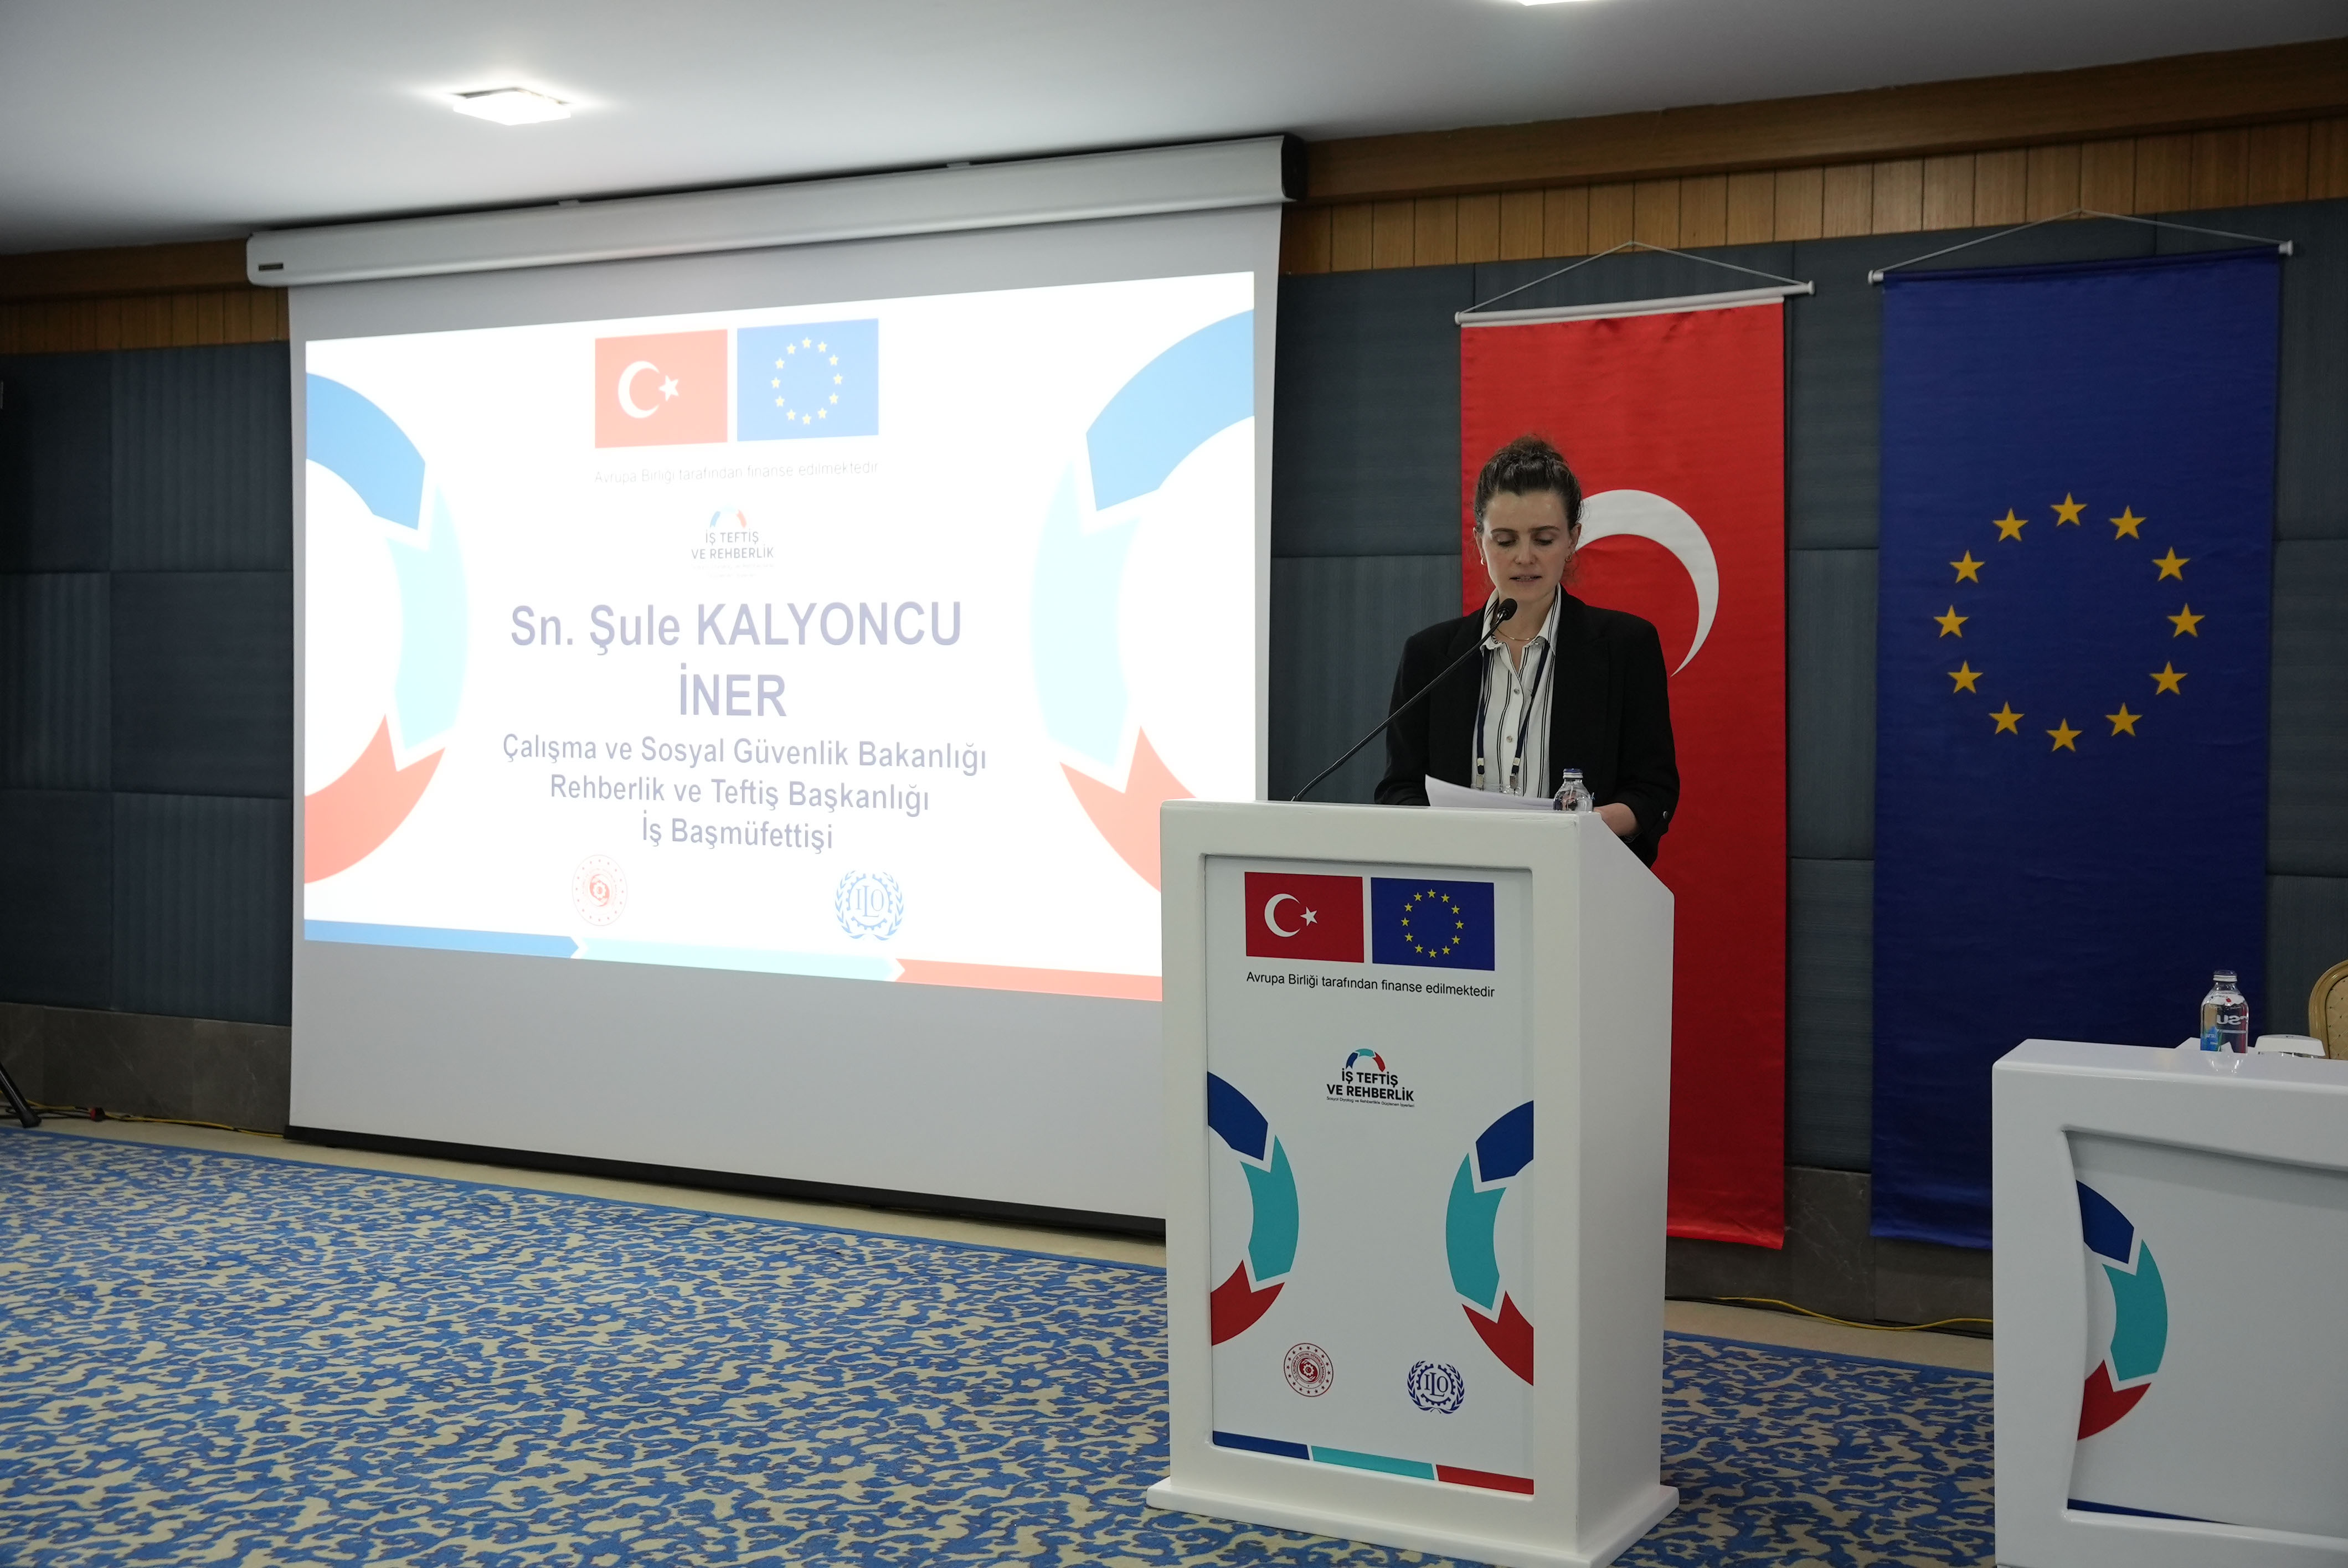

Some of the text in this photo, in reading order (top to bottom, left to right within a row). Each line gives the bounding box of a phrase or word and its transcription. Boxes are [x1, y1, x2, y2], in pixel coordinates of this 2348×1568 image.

[594, 471, 637, 484] Avrupa
[679, 466, 742, 481] tarafından
[747, 465, 794, 477] finanse
[706, 529, 759, 545] İŞ TEFTİŞ
[692, 543, 773, 559] VE REHBERLİK
[512, 601, 960, 656] Sn. Şule KALYONCU
[681, 663, 786, 716] İNER
[504, 734, 985, 776] Çalışma ve Sosyal Güvenlik Bakanlığı
[552, 774, 928, 817] Rehberlik ve Teftiş Başkanlığı
[643, 810, 831, 854] İş Başmüfettişi
[854, 883, 885, 919] ILO
[1247, 972, 1495, 997] Avrupa Birliği tarafından finanse edilmektedir
[1342, 1068, 1398, 1087] İŞ TEFTİŞ
[1327, 1084, 1414, 1101] VE REHBERLİK
[1424, 1372, 1449, 1396] ILO
